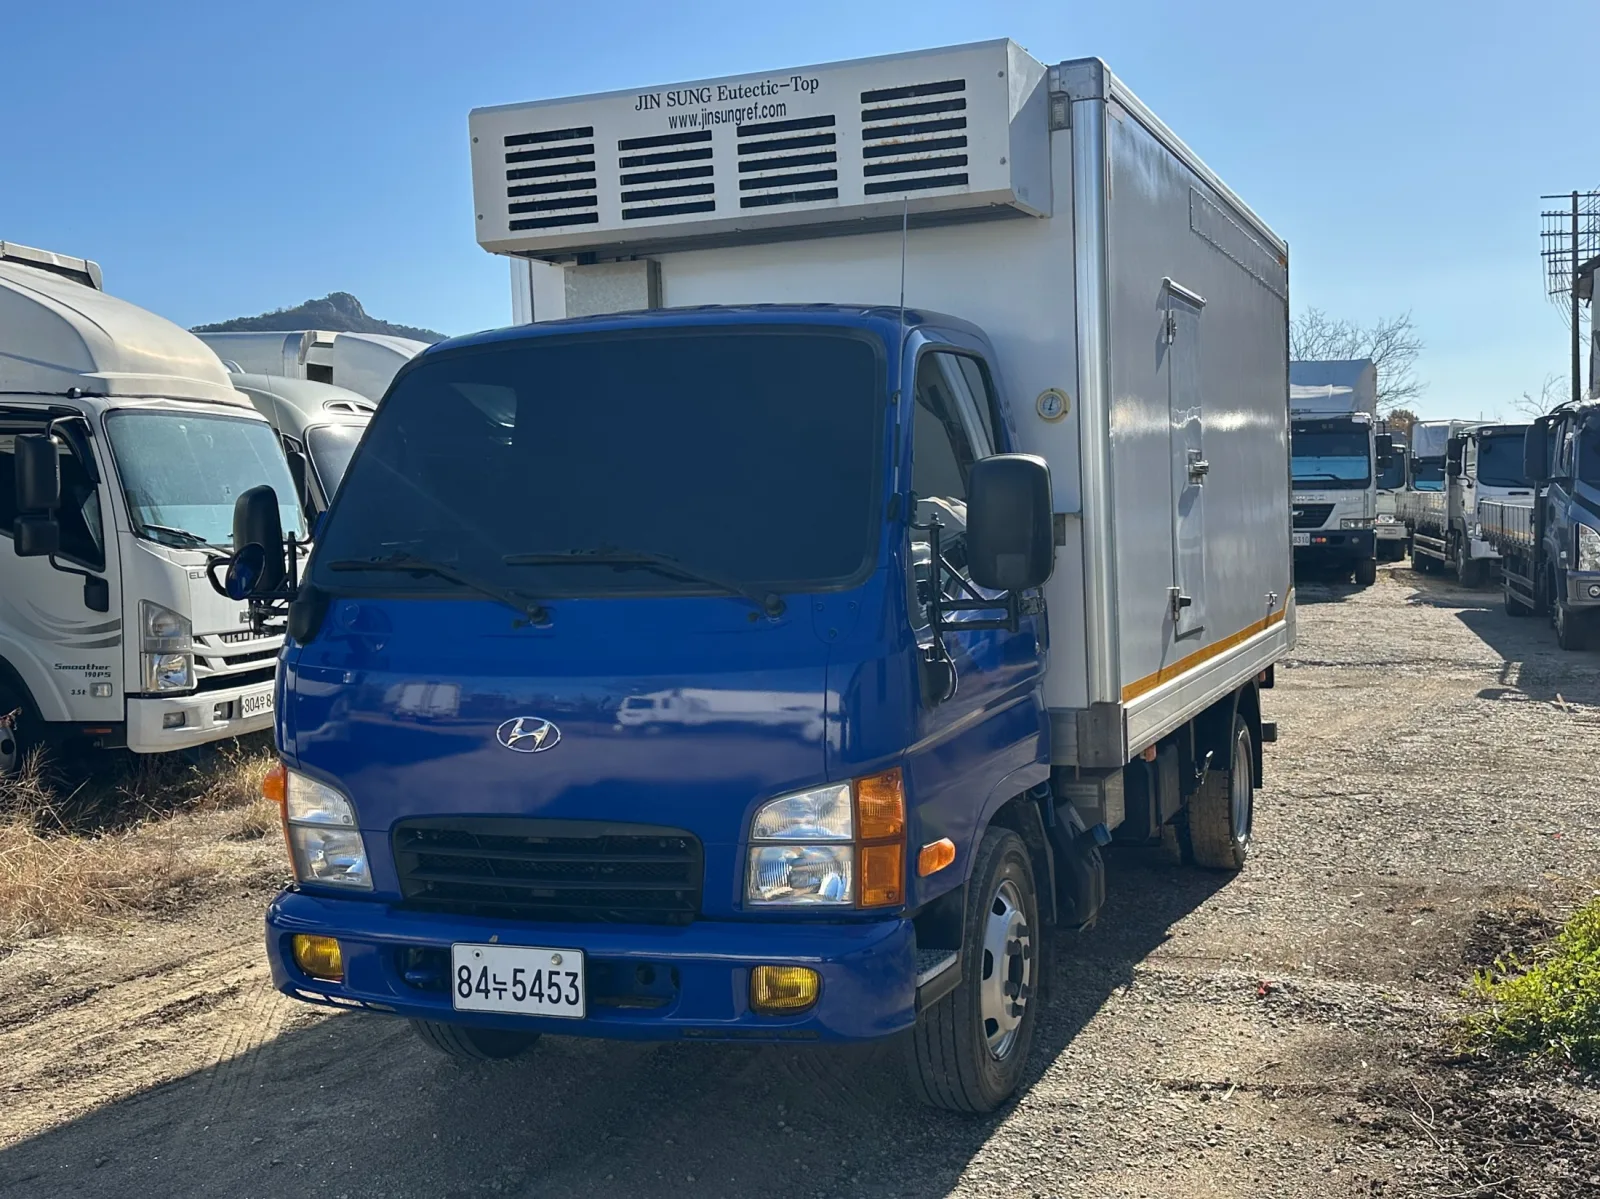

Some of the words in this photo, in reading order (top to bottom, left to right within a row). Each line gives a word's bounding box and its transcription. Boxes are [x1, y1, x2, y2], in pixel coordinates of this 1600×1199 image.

[635, 93, 661, 111] JIN
[666, 87, 713, 107] SUNG
[717, 75, 819, 102] Eutectic-Top
[668, 102, 787, 130] www.jinsungref.com
[54, 663, 111, 671] Smoother
[457, 965, 580, 1006] 84누5453
